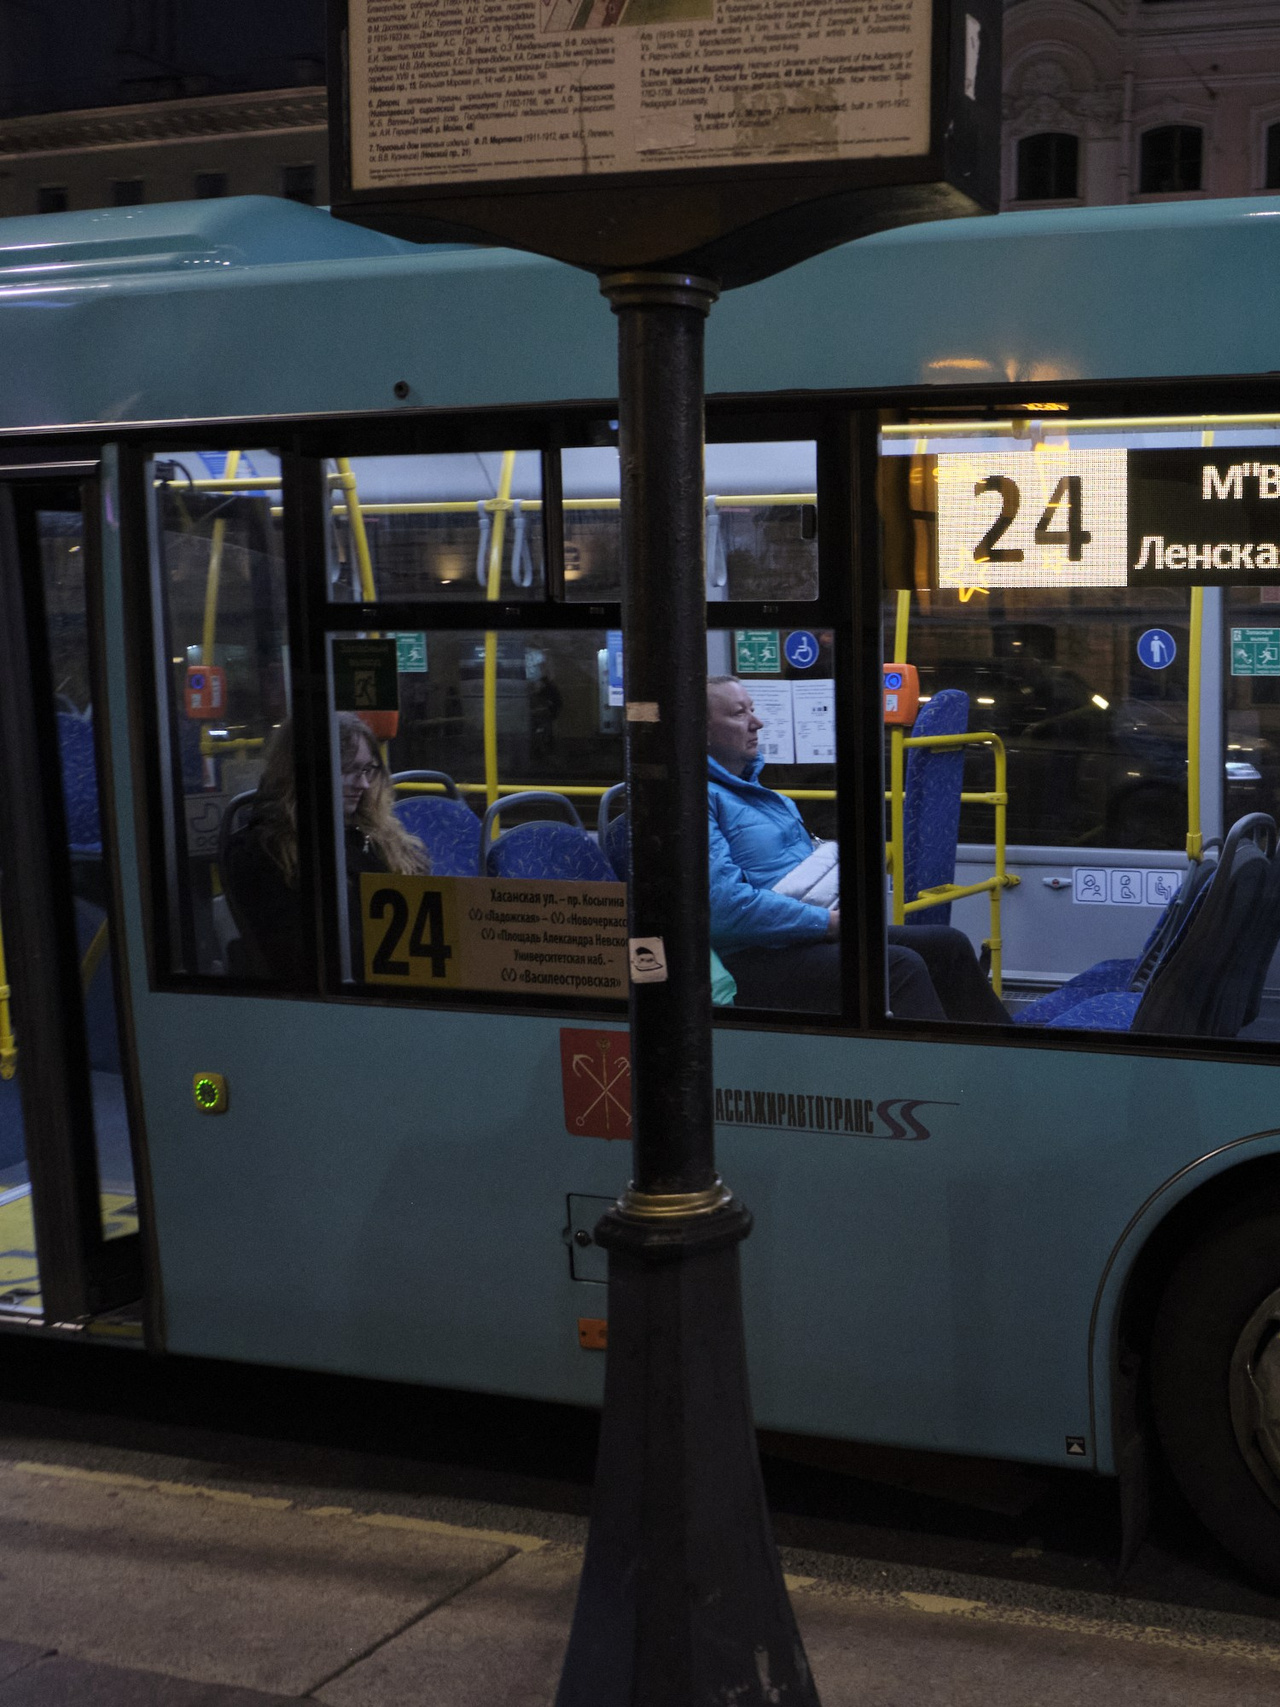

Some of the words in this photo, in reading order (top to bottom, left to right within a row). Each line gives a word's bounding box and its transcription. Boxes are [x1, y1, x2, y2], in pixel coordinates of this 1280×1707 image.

[971, 474, 1093, 562] 24
[490, 889, 540, 904] Хасанская
[543, 894, 558, 908] ул.
[567, 896, 581, 908] пр.
[582, 894, 624, 908] Косыгина
[369, 888, 452, 978] 24
[542, 933, 594, 948] Александра
[513, 950, 585, 966] Университетская
[587, 953, 606, 965] наб.
[520, 970, 621, 989] «Василеостровская»
[716, 1088, 874, 1134] АССАЖИРАВТОТРАНС
